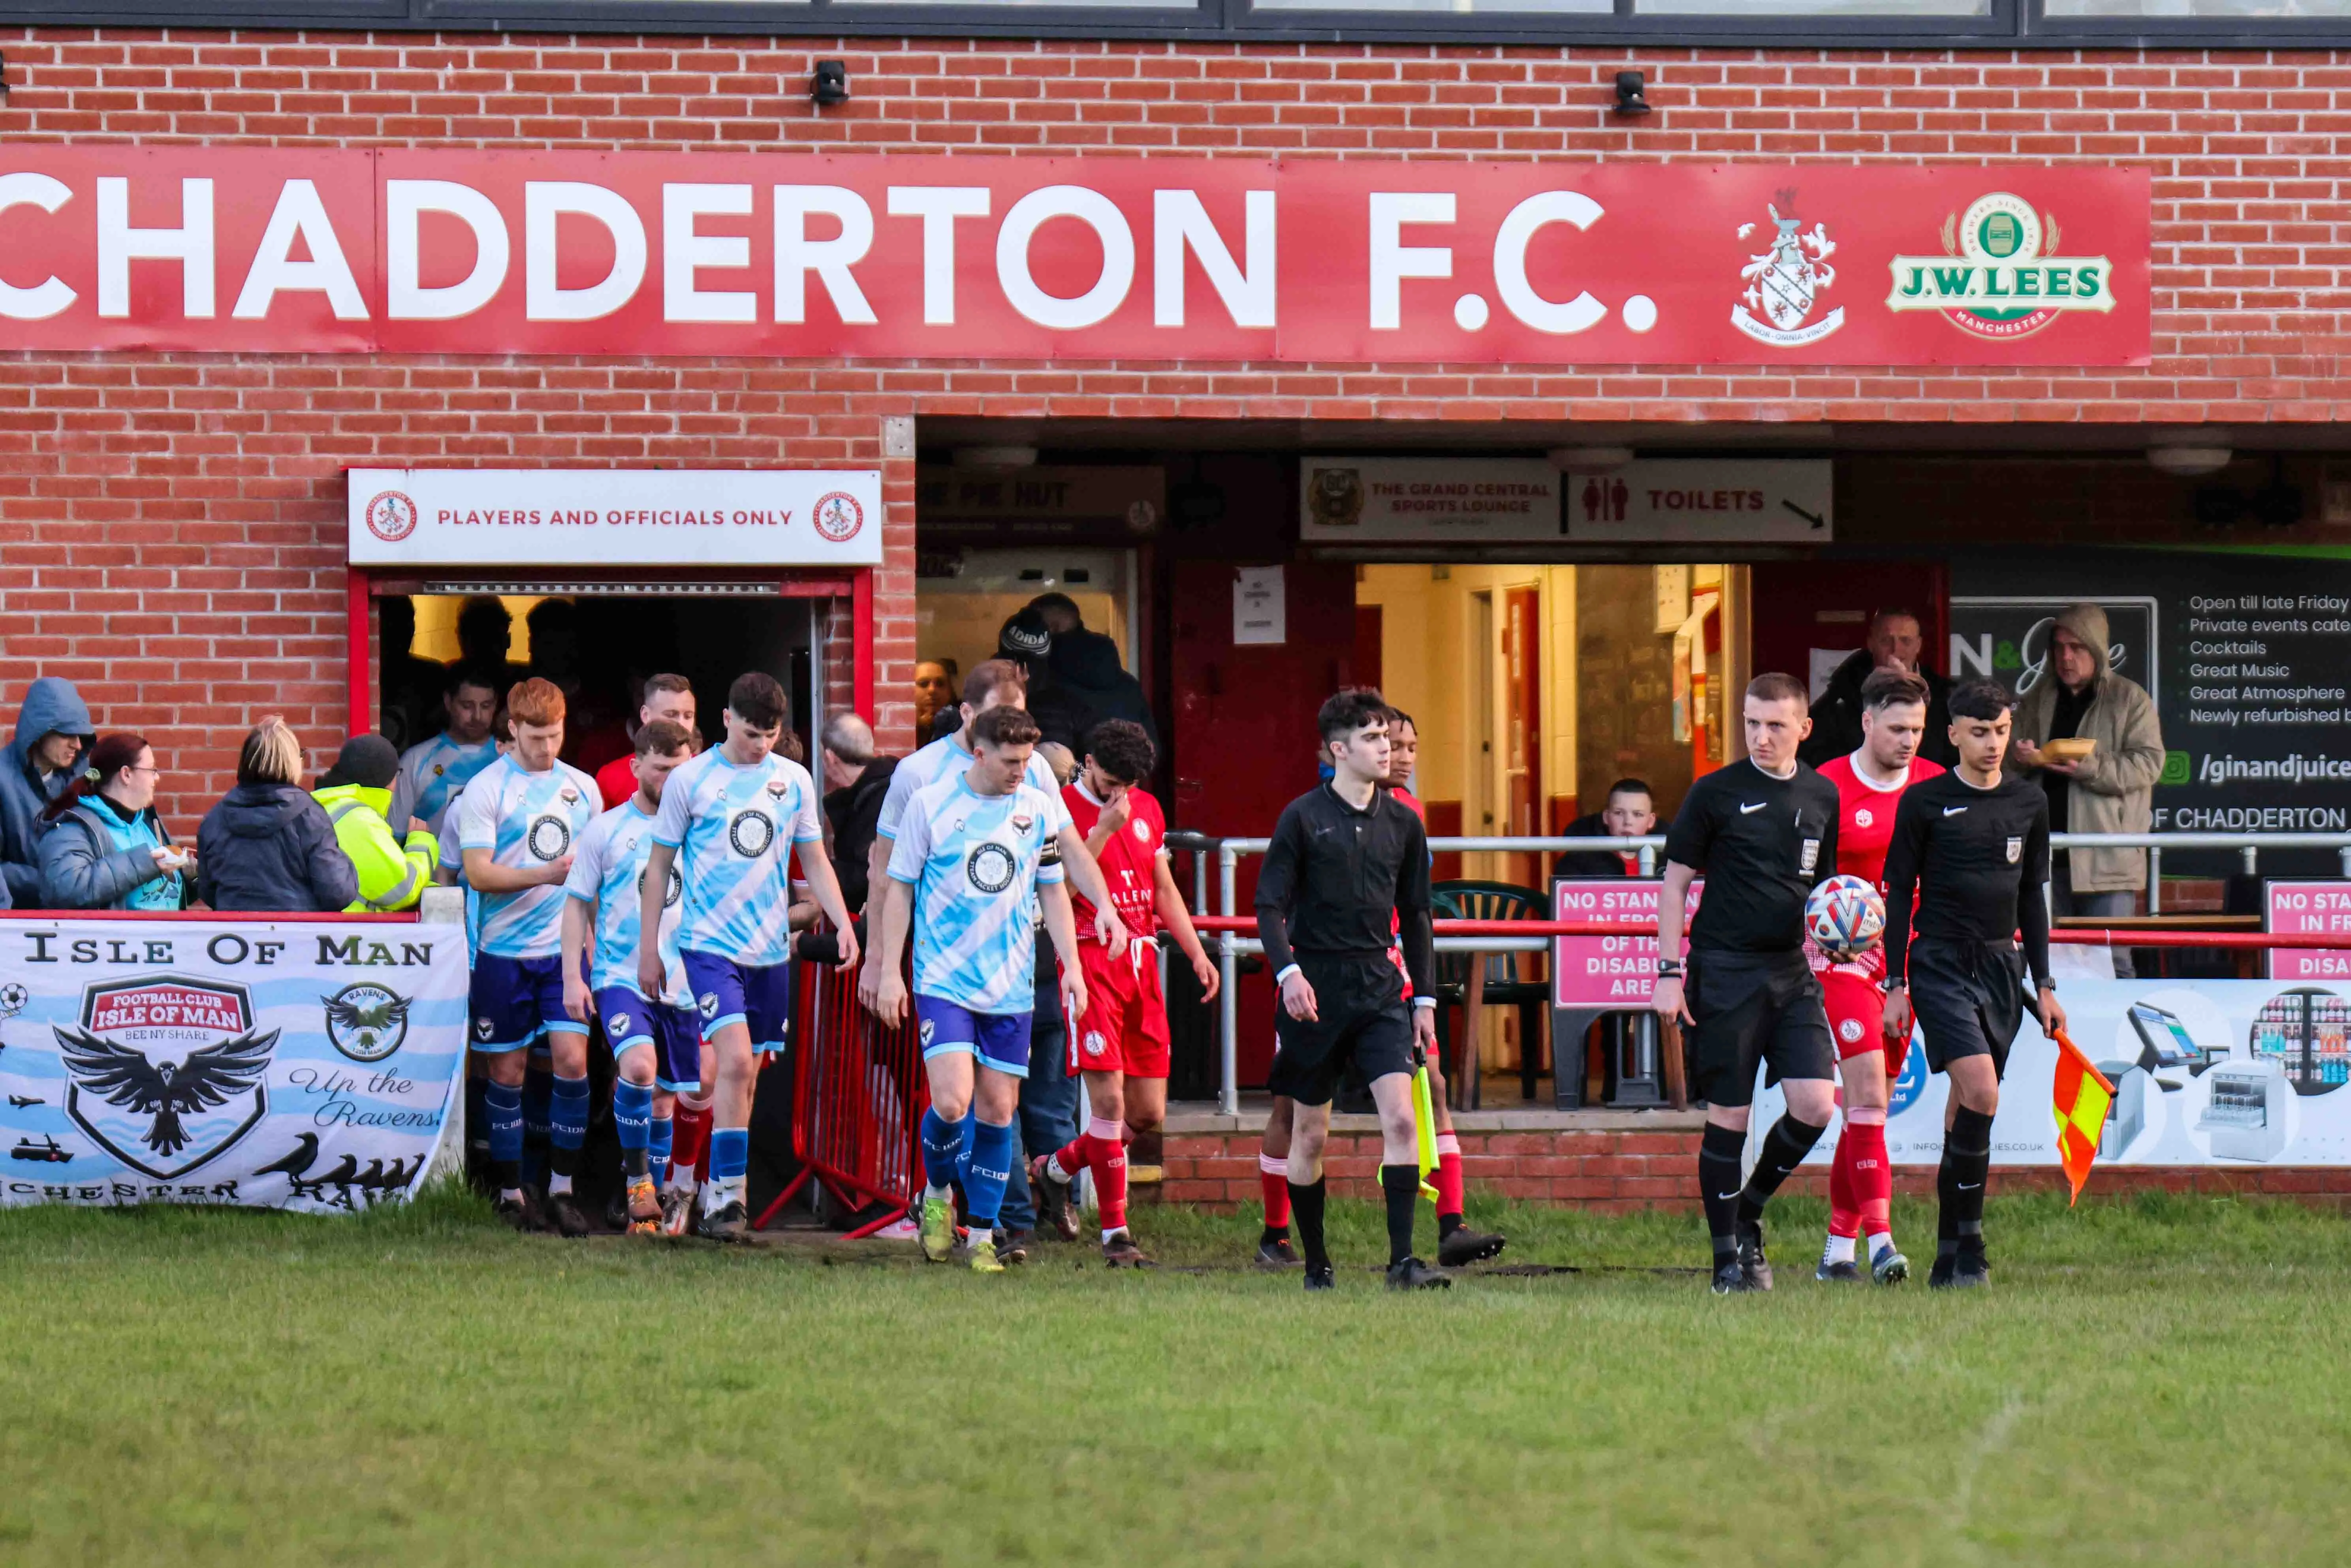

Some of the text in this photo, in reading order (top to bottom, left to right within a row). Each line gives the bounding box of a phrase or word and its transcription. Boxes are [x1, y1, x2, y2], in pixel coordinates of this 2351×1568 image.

[0, 172, 1657, 335] CHADDERTON F.C.
[1982, 266, 2100, 297] LEES
[1744, 321, 1770, 338] LABOR
[1956, 311, 2046, 333] MANCHESTER
[1372, 483, 1551, 496] THE GRAND CENTRAL
[1391, 500, 1531, 512] SPORTS LOUNGE
[1647, 490, 1764, 510] TOILETS
[438, 510, 792, 525] PLAYERS AND OFFICIALS ONLY
[2190, 596, 2349, 613] Open till late Friday
[2190, 618, 2248, 632] Private
[2252, 619, 2308, 632] events
[2190, 641, 2266, 654] Cocktails
[2190, 663, 2289, 677] Great Music
[2190, 686, 2345, 703] Great Atmosphere
[2190, 708, 2239, 726] Newly
[2245, 708, 2340, 722] refurbished
[2199, 754, 2351, 784] /ginandjuice
[2150, 807, 2345, 828] F CHADDERTON
[1563, 892, 1596, 908] NO
[2276, 893, 2308, 909] NO
[2300, 914, 2323, 931] IN
[24, 932, 434, 966] ISLE OF MAN
[1602, 936, 1659, 951] OF TH
[2299, 958, 2351, 974] DISA
[348, 989, 386, 1000] RAVENS
[1610, 979, 1659, 995] ARE
[113, 992, 222, 1007] FOOTBALL CLUB
[96, 1006, 237, 1028] ISLE OF MAN
[126, 1030, 209, 1040] BEE NY SHARE
[290, 1067, 414, 1101] Up the
[0, 1180, 240, 1201] CHESTER
